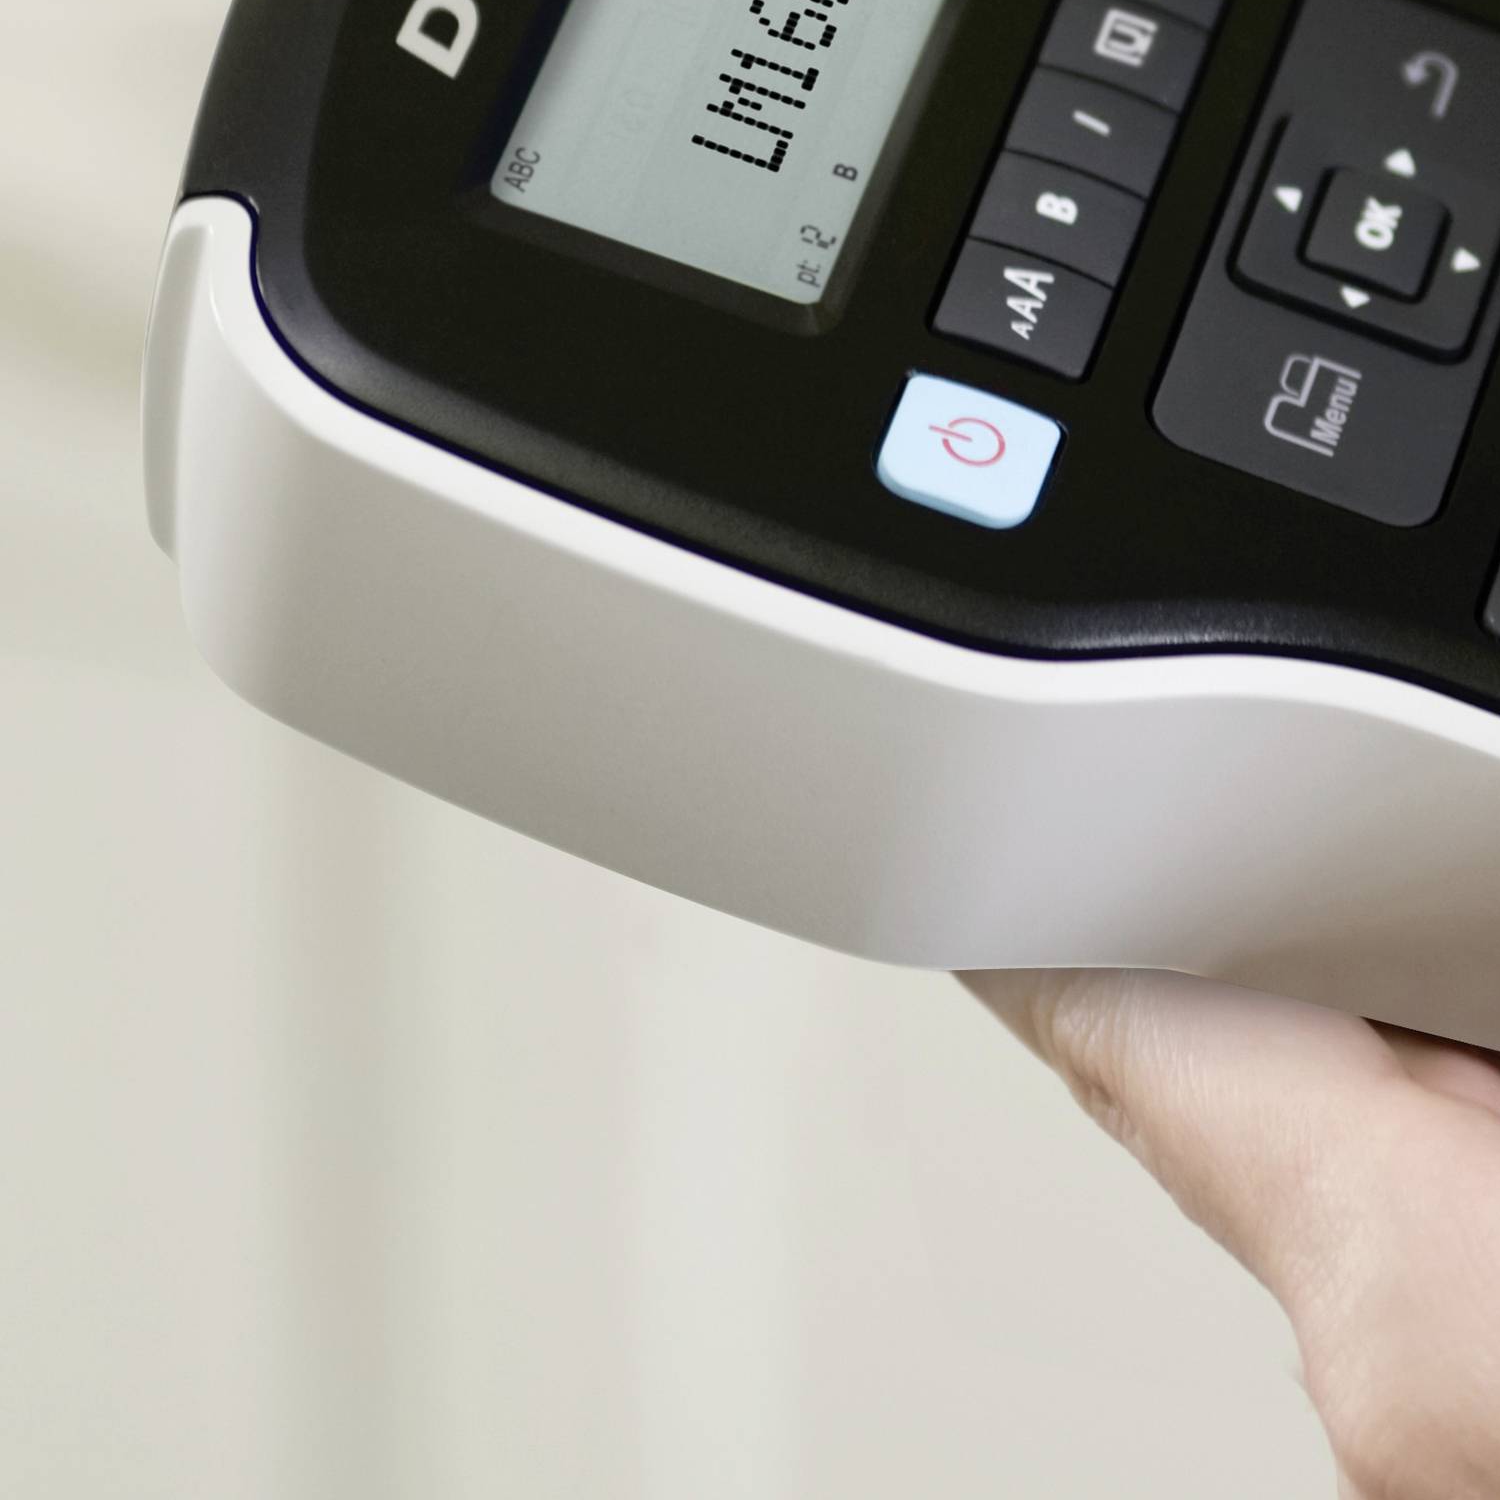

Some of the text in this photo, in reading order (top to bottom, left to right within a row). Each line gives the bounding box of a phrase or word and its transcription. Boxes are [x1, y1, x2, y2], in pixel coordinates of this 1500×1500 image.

[502, 146, 541, 193] ABC
[832, 163, 859, 182] B
[1035, 192, 1078, 225] B
[1355, 197, 1402, 250] OK
[1312, 381, 1359, 446] Menu
